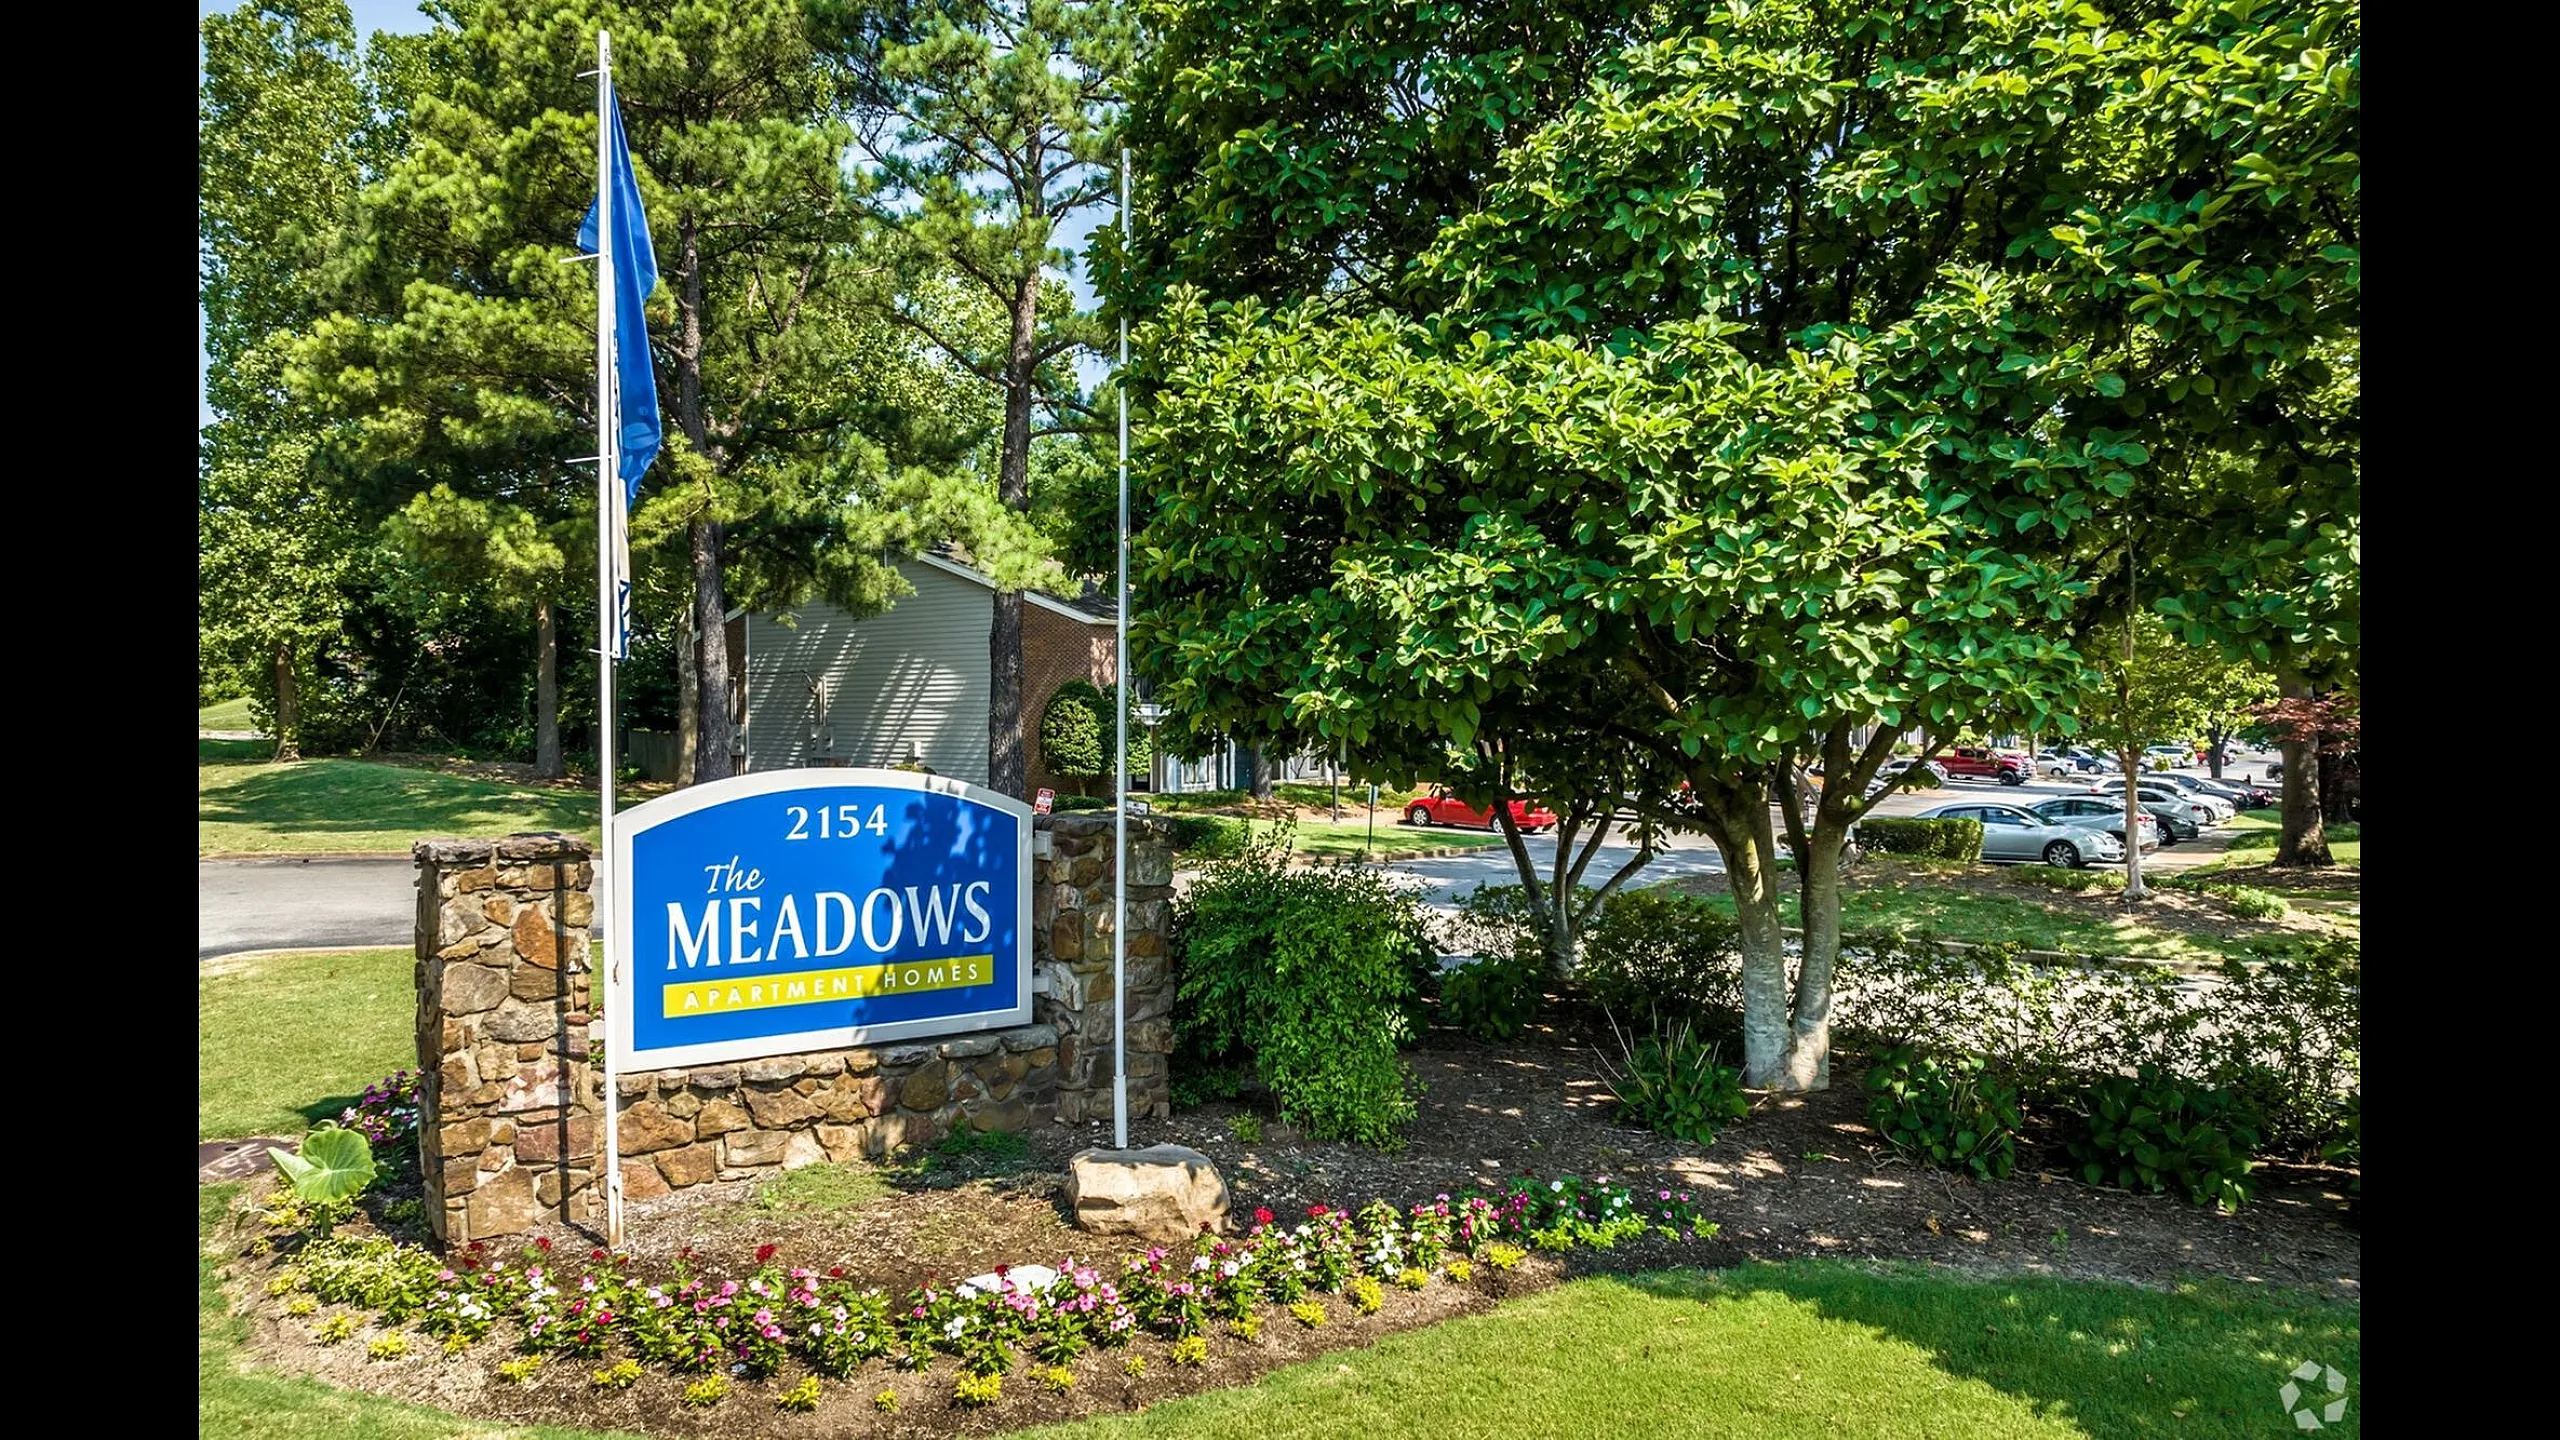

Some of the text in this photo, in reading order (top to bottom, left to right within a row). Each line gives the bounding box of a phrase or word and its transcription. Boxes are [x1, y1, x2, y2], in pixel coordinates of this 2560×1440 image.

[785, 804, 888, 840] 2154
[704, 855, 765, 894] The
[666, 881, 991, 970] MEADOWS
[683, 963, 978, 1010] APARTMENT HOMES
